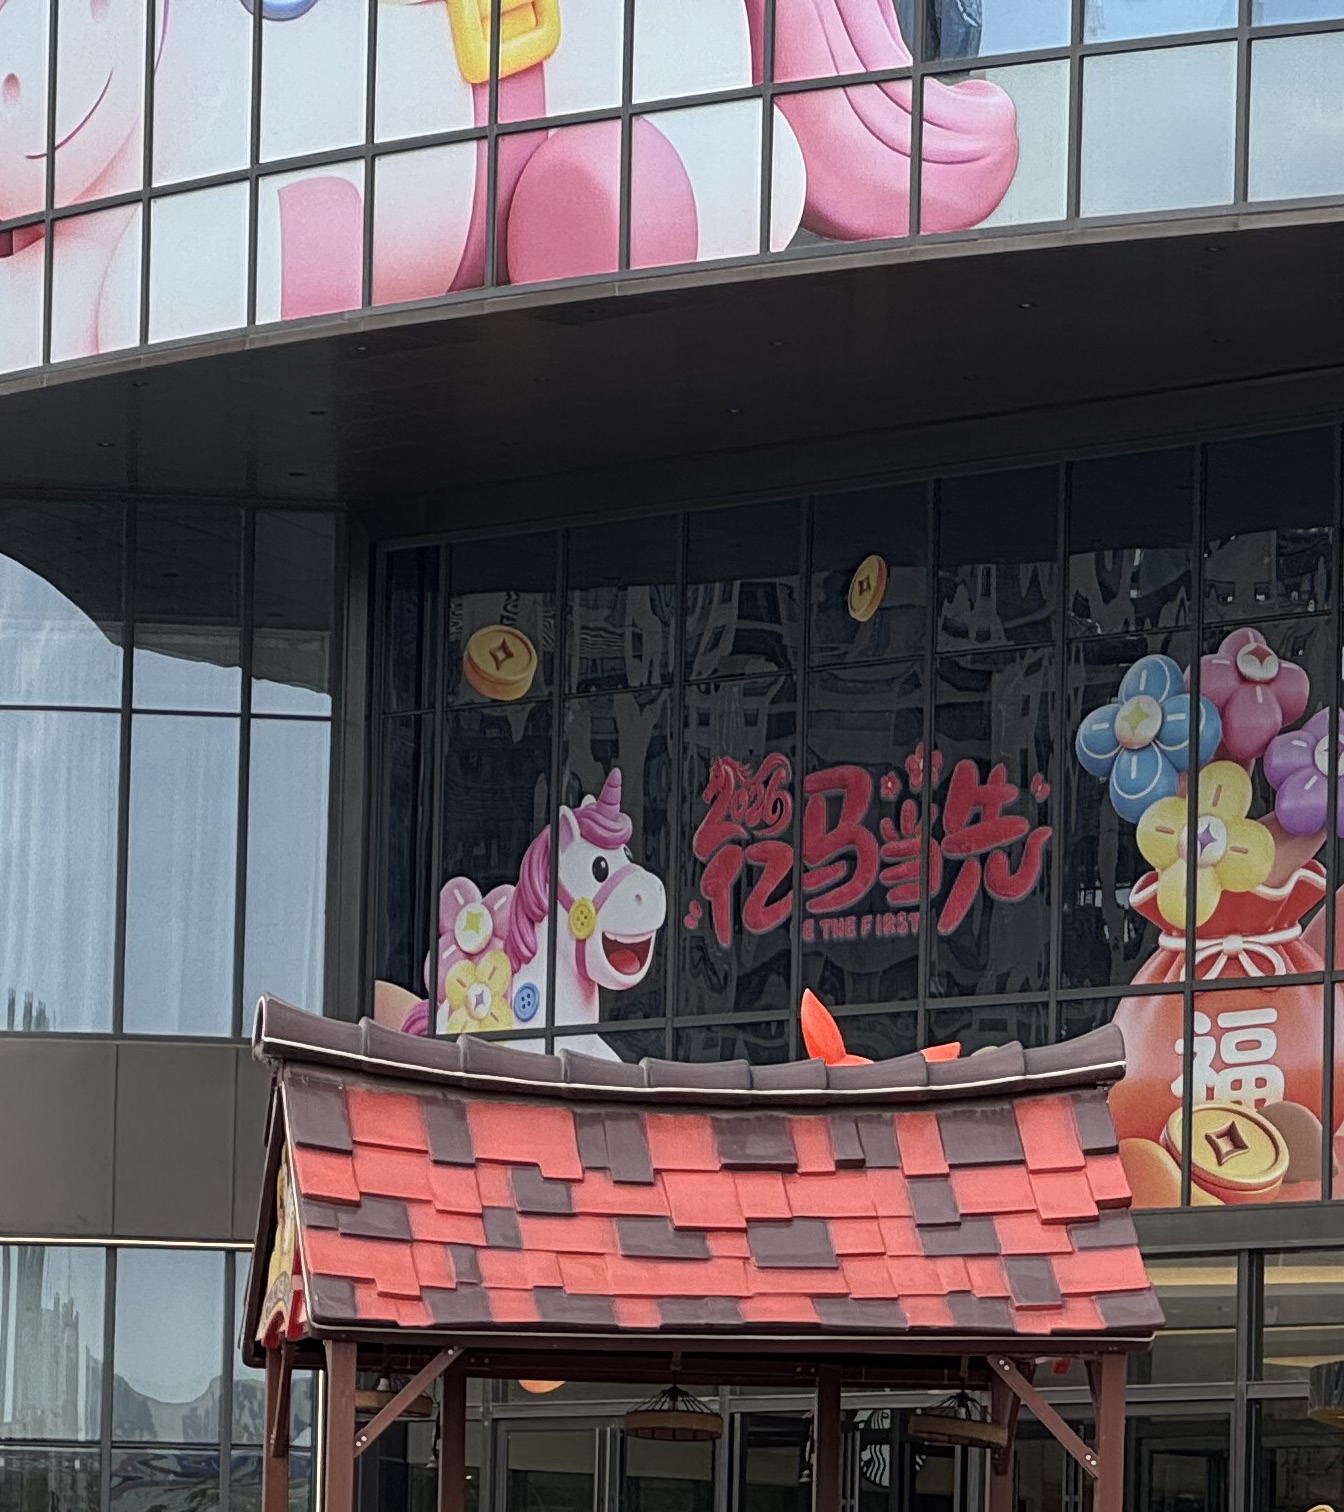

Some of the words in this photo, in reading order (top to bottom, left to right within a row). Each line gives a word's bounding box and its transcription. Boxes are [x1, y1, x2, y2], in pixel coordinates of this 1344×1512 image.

[820, 917, 857, 940] THE
[860, 911, 922, 938] FIRST
[1170, 1008, 1285, 1112] 福
